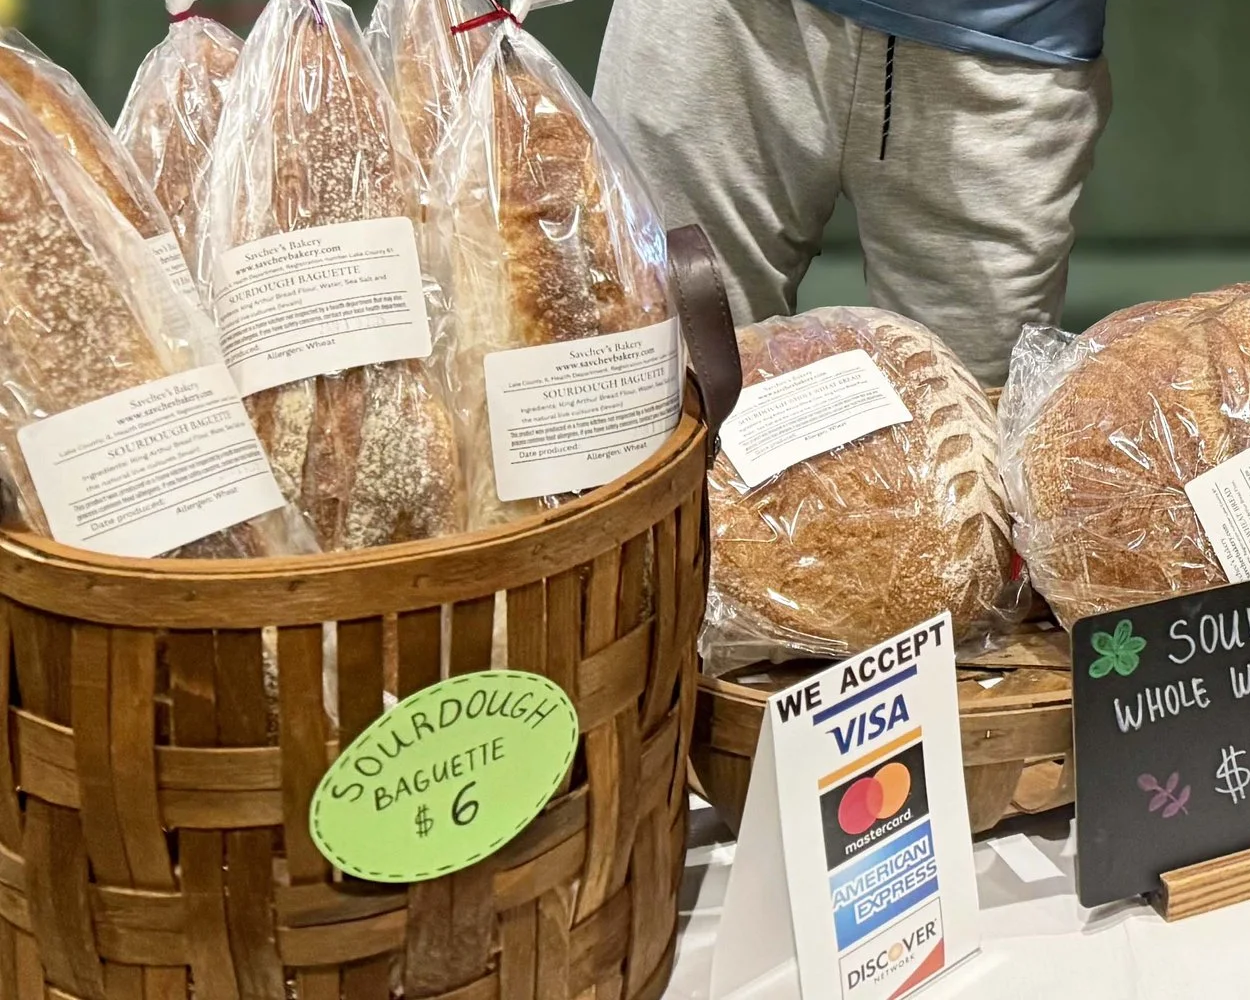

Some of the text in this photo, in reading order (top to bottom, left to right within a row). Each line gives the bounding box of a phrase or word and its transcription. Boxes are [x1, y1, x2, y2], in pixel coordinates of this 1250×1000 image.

[243, 238, 322, 261] Savchev's Bakery
[228, 276, 295, 304] SOURDOUGH
[297, 264, 361, 284] BAGUETTE
[305, 338, 336, 350] Wheat
[555, 347, 655, 371] www.savchevbakery.com
[569, 340, 642, 359] Savchev's Bakery
[542, 378, 618, 399] SOURDOUGH
[620, 367, 665, 387] BAGUETTE
[107, 423, 188, 458] SOURDOUGH
[519, 449, 537, 459] Date
[586, 442, 648, 461] Allergen: Wheat
[1224, 487, 1240, 513] BREAD
[90, 518, 115, 531] Date
[776, 620, 945, 724] WE ACCEPT
[825, 693, 910, 756] VISA
[1113, 677, 1211, 734] WHOLE
[331, 688, 559, 803] SOURDOUGH
[373, 736, 506, 812] BAGUETTE
[1214, 744, 1250, 804] $
[414, 780, 480, 839] $ 6
[845, 807, 914, 855] mastercard
[832, 838, 930, 911] AMERICAN
[855, 859, 938, 924] EXPRESS
[847, 920, 937, 991] DISCOVER
[873, 953, 916, 985] NETWORK
